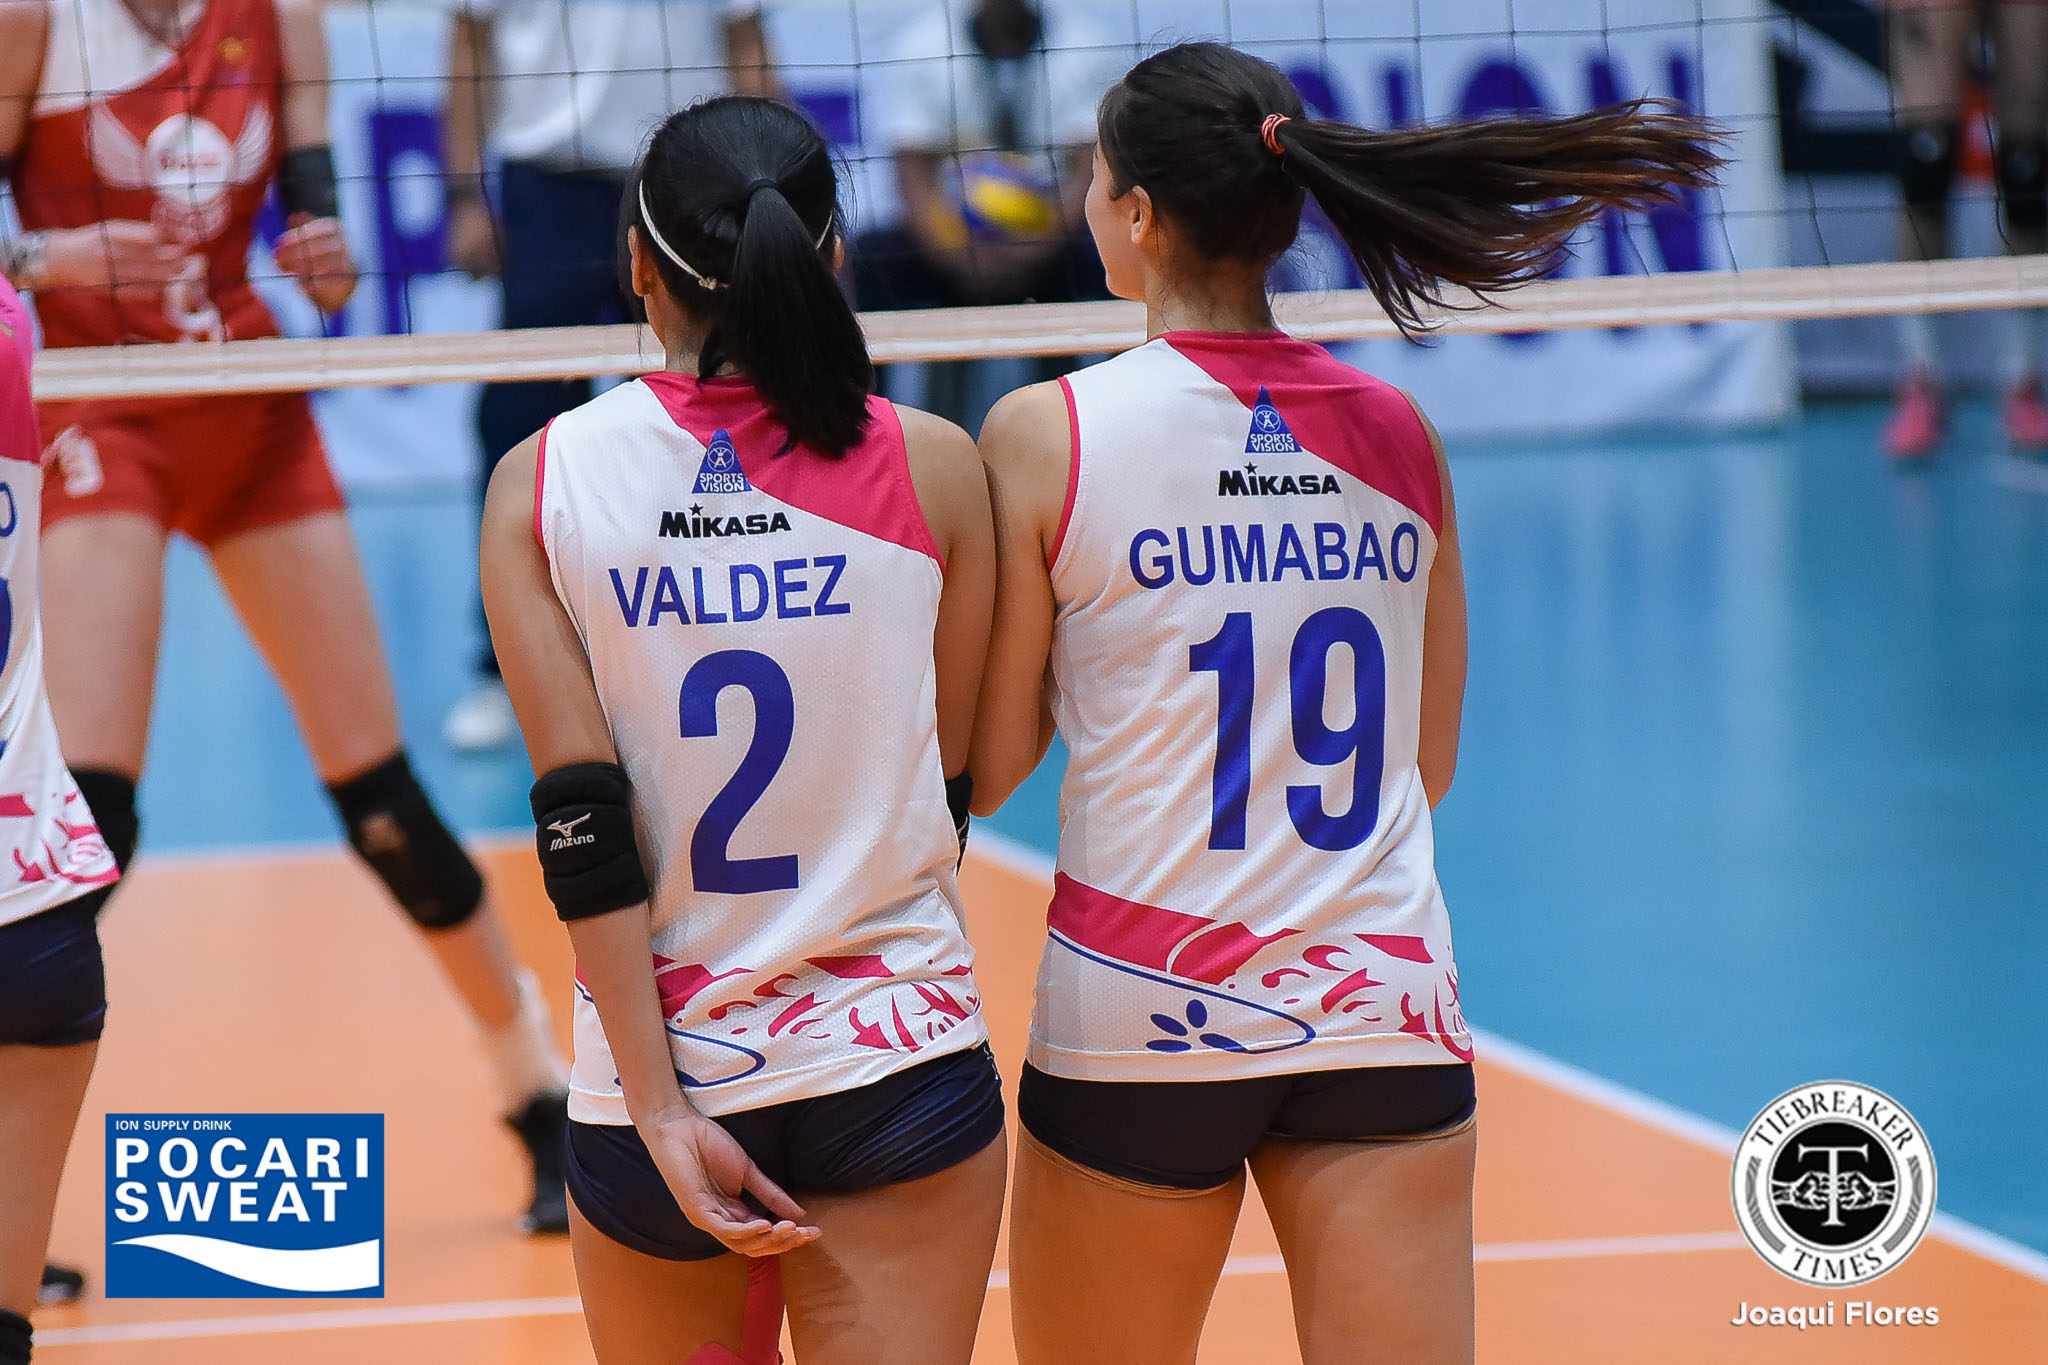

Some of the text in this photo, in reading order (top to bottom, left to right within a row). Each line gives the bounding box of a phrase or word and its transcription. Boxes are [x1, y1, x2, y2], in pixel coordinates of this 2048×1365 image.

[1250, 433, 1294, 443] SPORTS
[1252, 442, 1296, 452] VISION
[699, 472, 744, 483] SPORTS
[700, 482, 745, 492] VISION
[1129, 522, 1419, 590] GUMABAO
[608, 554, 851, 628] VALDEZ
[1189, 606, 1386, 851] 19
[679, 649, 799, 894] 2
